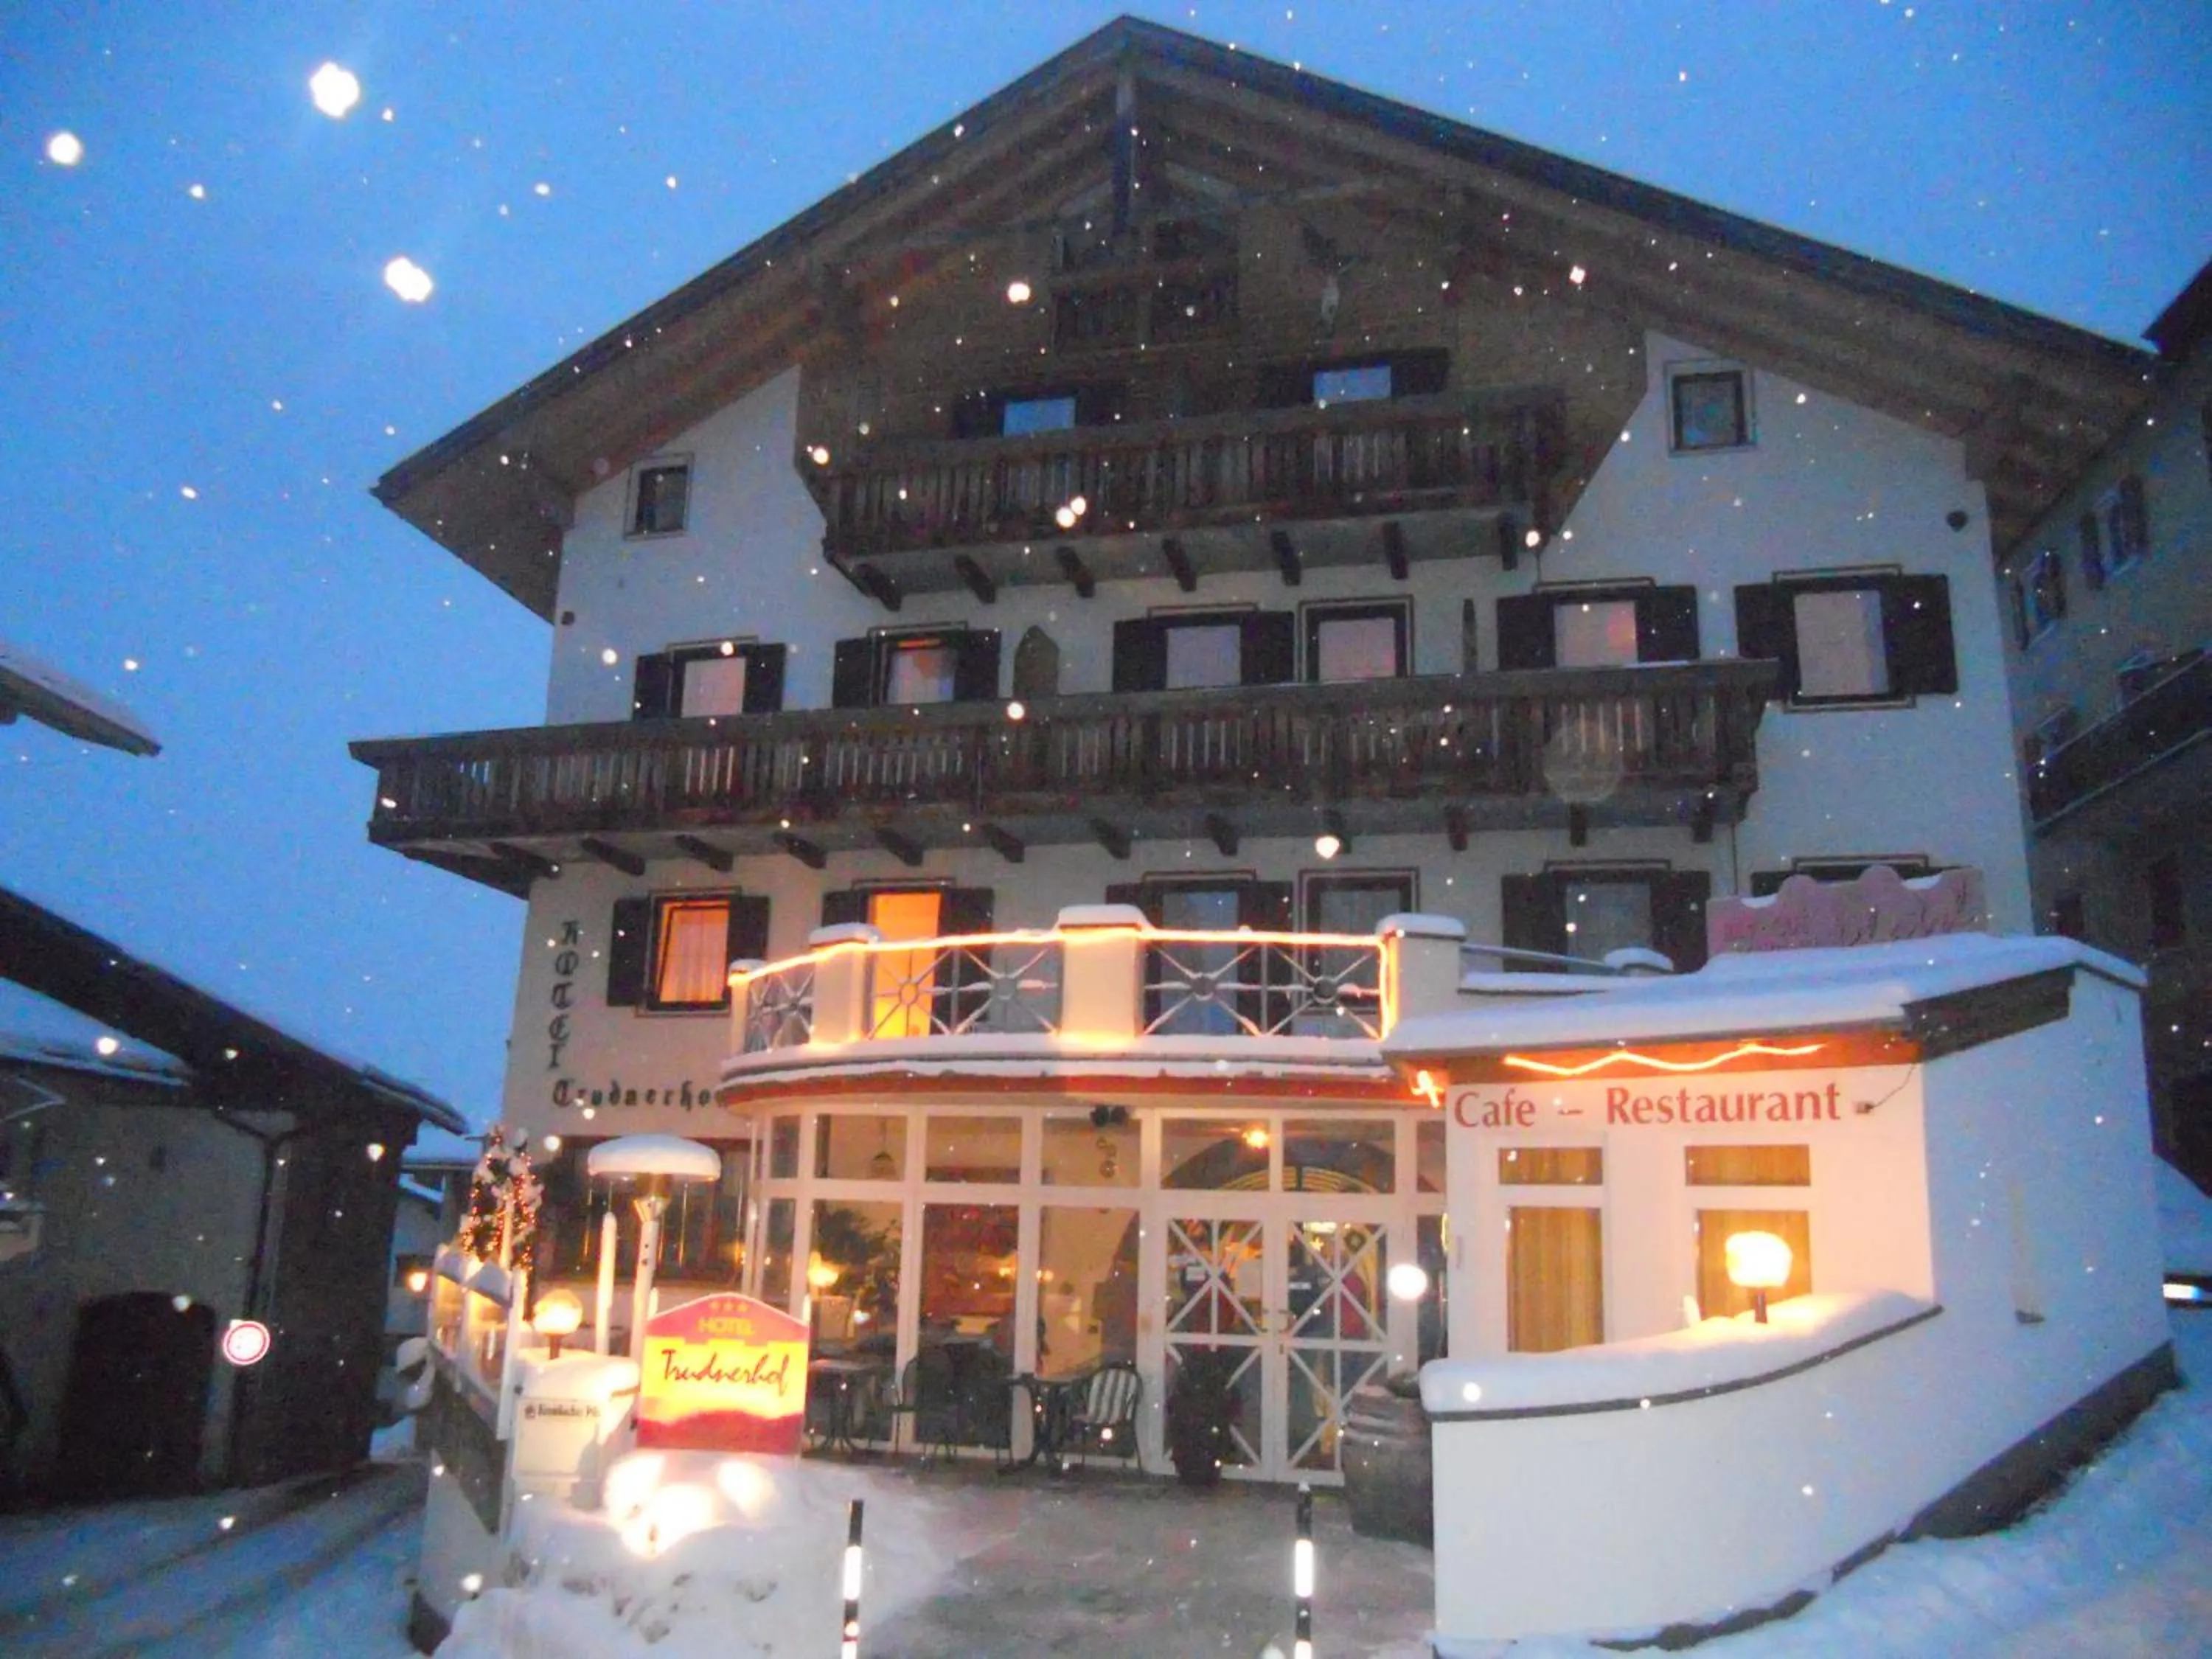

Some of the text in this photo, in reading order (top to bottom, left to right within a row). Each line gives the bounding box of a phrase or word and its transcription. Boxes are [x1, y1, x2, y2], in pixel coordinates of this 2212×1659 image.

[1454, 1087, 1536, 1127] Cafe
[1606, 1082, 1842, 1125] Restaurant
[698, 1316, 754, 1336] HOTEL
[661, 1349, 790, 1397] Trudnerhof
